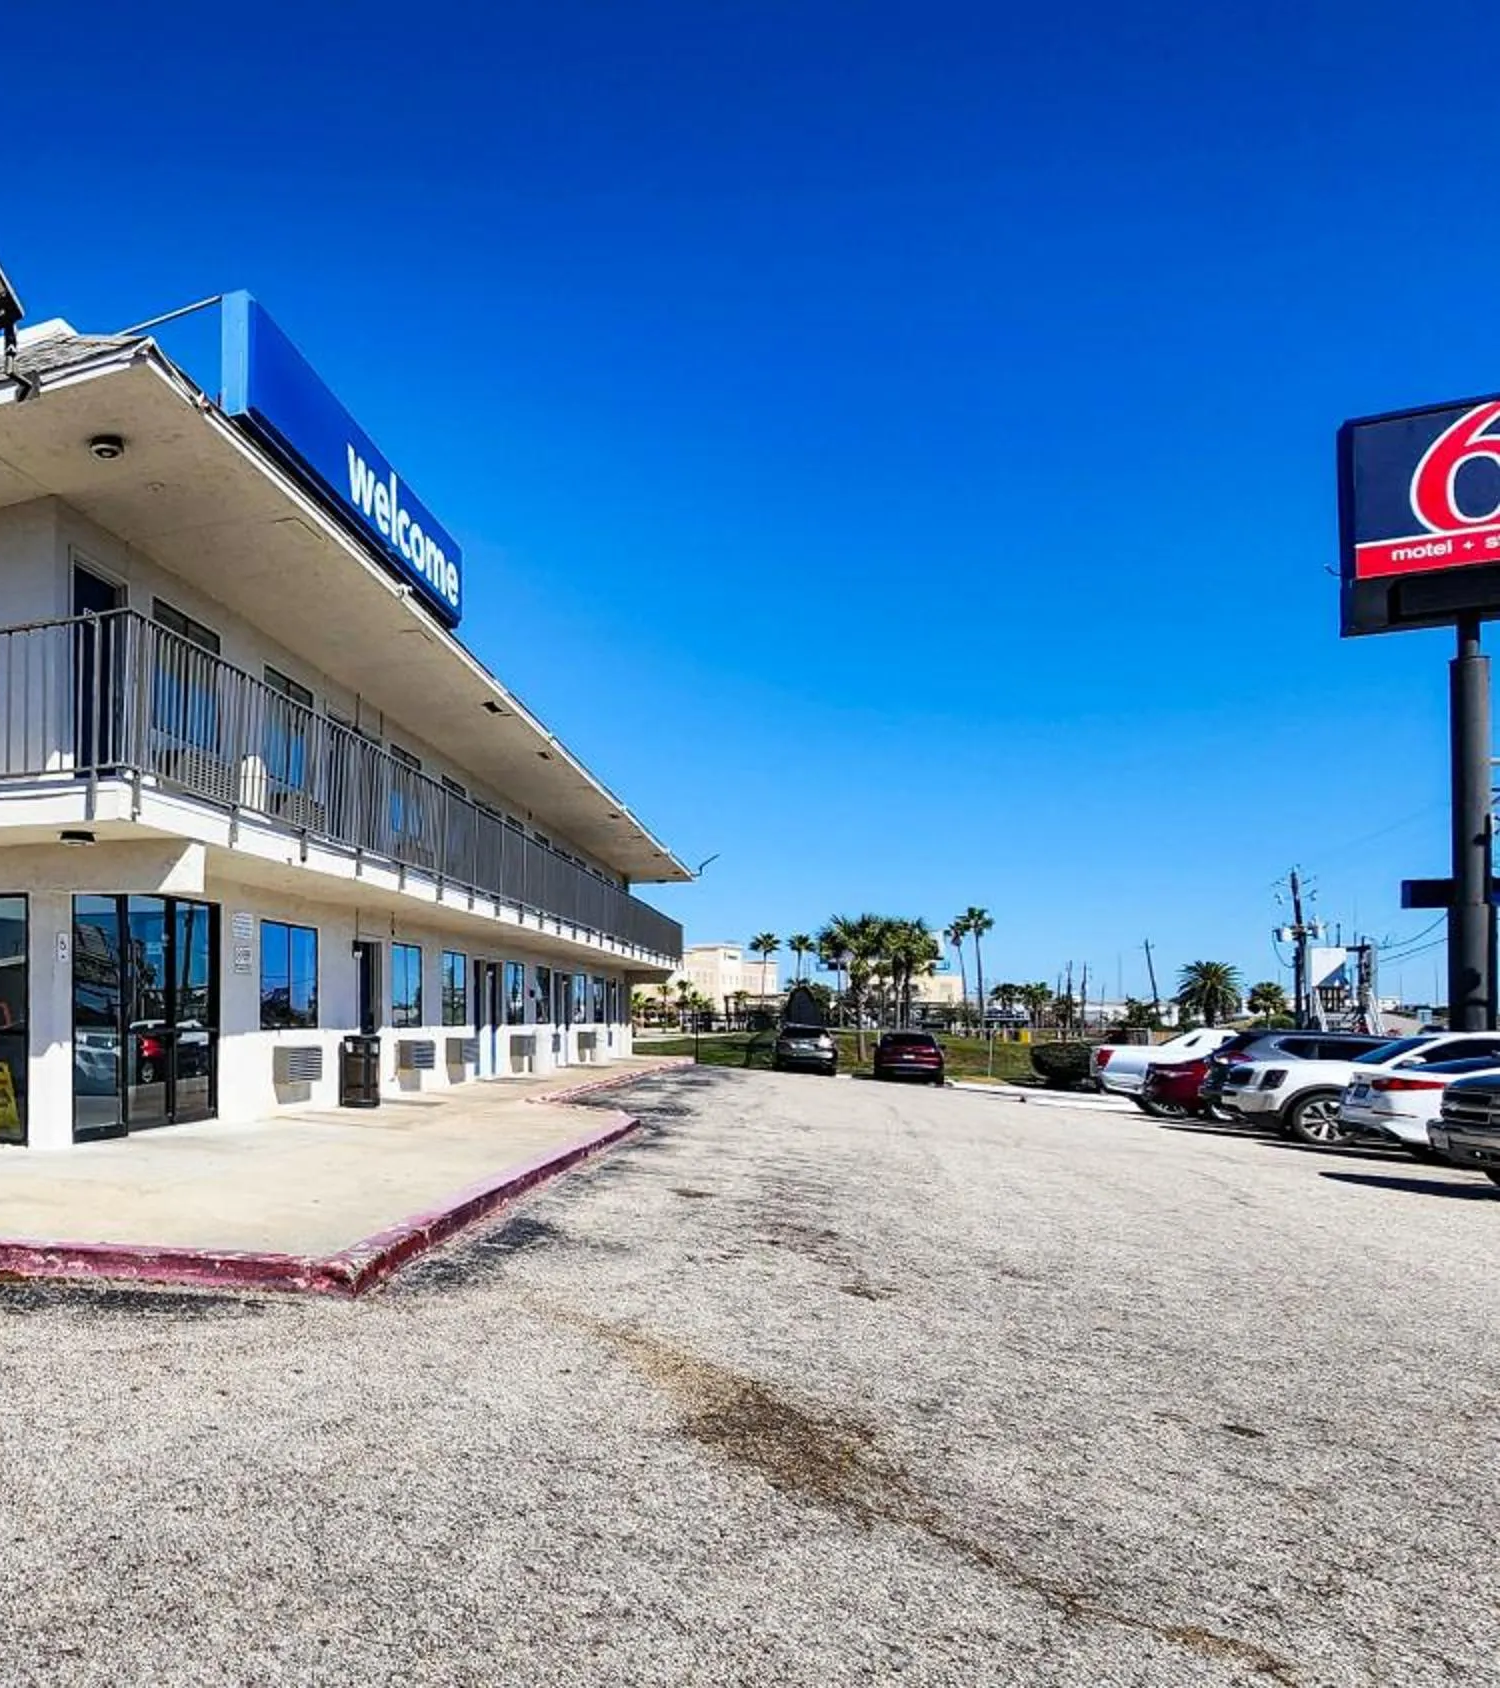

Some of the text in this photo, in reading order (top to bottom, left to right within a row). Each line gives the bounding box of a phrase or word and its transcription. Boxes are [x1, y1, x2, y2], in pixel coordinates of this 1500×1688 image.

[347, 443, 459, 607] welcome
[1409, 400, 1500, 535] 6
[1392, 539, 1452, 561] motel
